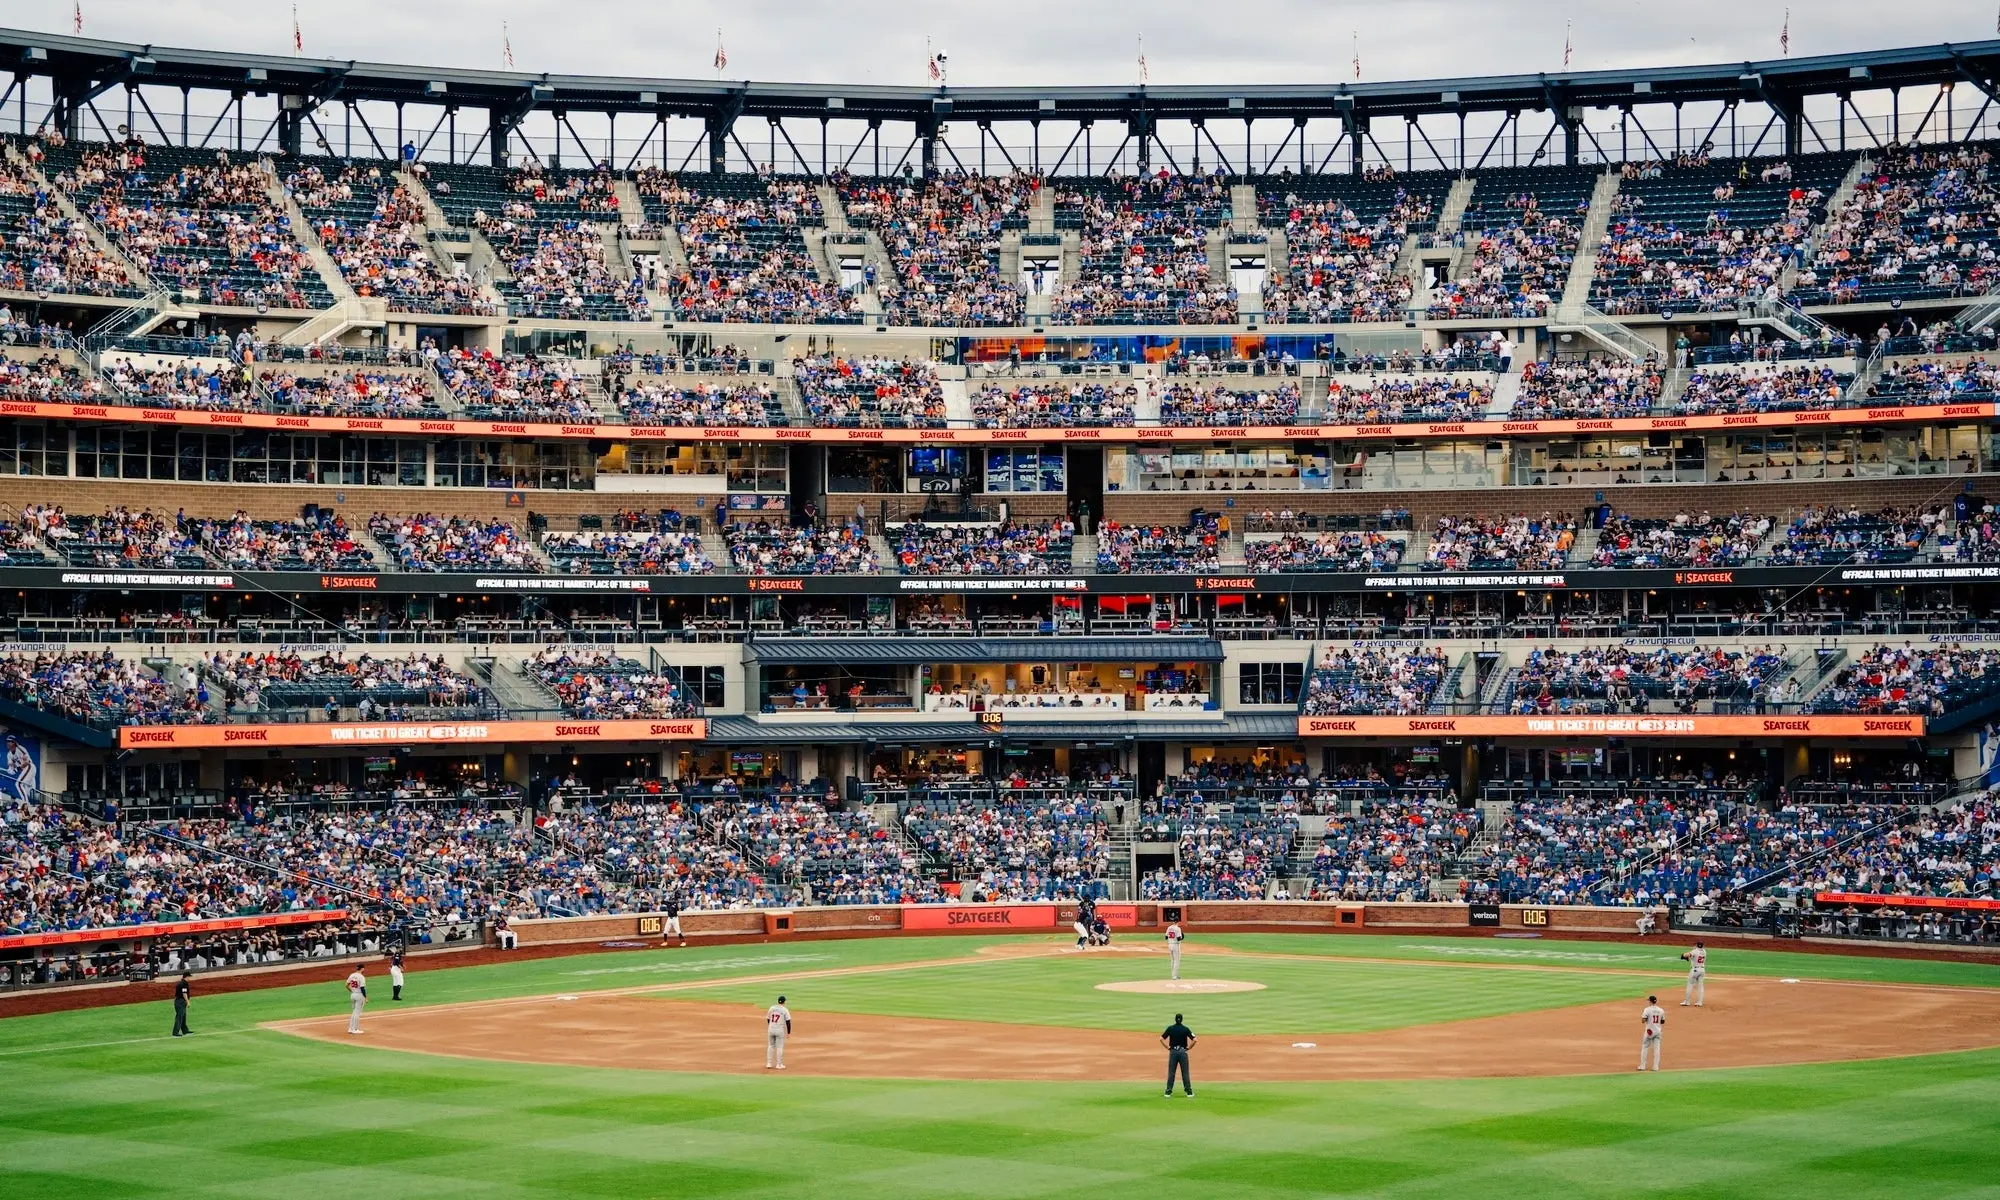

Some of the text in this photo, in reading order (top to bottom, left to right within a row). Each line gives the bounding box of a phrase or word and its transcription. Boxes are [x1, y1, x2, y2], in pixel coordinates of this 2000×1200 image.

[2, 404, 1980, 440] SEATGEEK SEATGEEK SEATGEEK SEATGEEK SEATGEEK SEATGEEK SEATGEEK SEATGEEK SEATGEEK SEATGEEK SEATGEEK SEATGEEK SEATGEEK SEATGEEK SEATGEEK SEATGEEK SEATGEEK SEATGEEK SEATGEEK SEATGEEK SEATGEEK SEATGEEK SEATGEEK SEATGEEK SEATGEEK SEATGEEK SEATGEEK SEATGEEK
[1687, 572, 1733, 583] SEATGEEK
[1842, 568, 1998, 579] OFFICIAL FAN TO FAN TICKET MARKETPLACE
[62, 574, 233, 585] OFFICIAL FAN TO FAN TICKET MARKETPLACE OF THE METS
[333, 577, 376, 588] SEATGEEK
[476, 579, 649, 588] OFFICIAL FAN TO FAN TICKET MARKETPLACE OF THE METS
[900, 580, 1086, 588] OFFICIAL FAN TO FAN TICKET MARKETPLACE OF THE METS
[1208, 578, 1255, 588] SEATGEEK
[1365, 576, 1564, 586] OFFICIAL FAN TO FAN TICKET MARKETPLACE OF THE METS
[760, 580, 803, 590] SEATGEEK
[983, 714, 1001, 722] 0:06
[1310, 720, 1912, 731] SEATGEEK SEATGEEK YOUR TICKET TO GREAT METS SEATS SEATGEEK SEATGEEK
[130, 724, 694, 742] SEATGEEK SEATGEEK YOUR TICKET TO GREAT METS SEATS SEATGEEK SEATGEEK
[948, 910, 1010, 924] SEATGEEK
[1060, 910, 1073, 918] citi
[1524, 910, 1546, 925] 0:06
[771, 1014, 780, 1023] 17
[1653, 1015, 1659, 1023] 11
